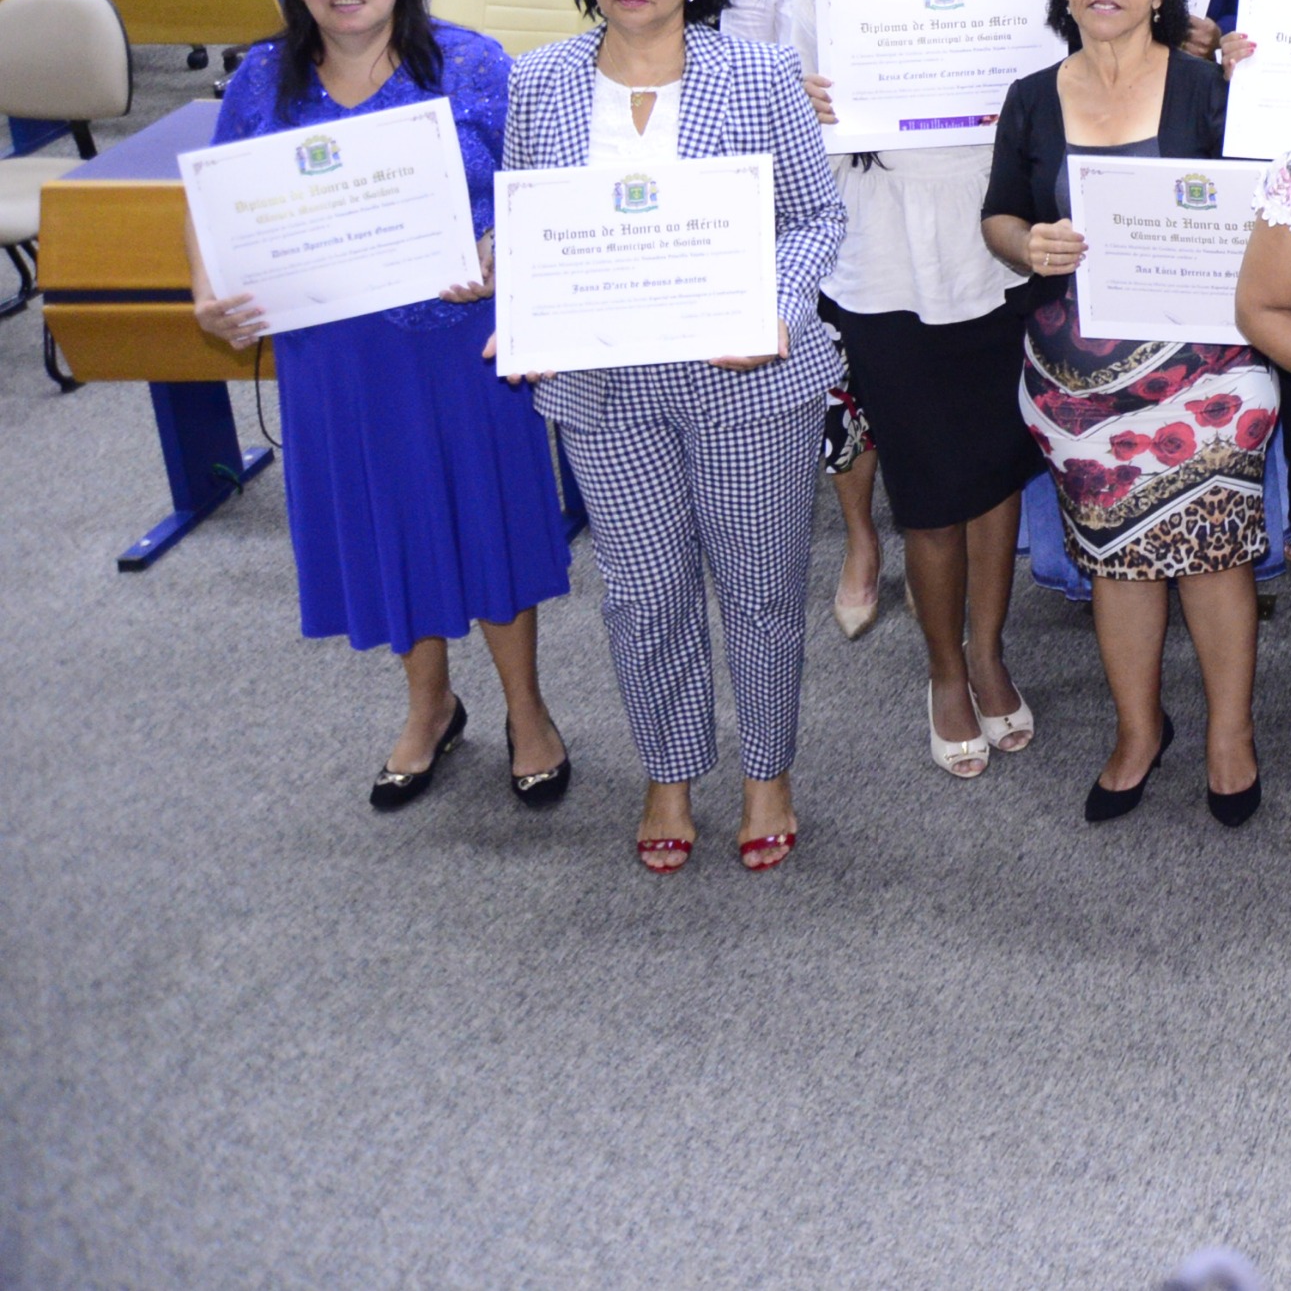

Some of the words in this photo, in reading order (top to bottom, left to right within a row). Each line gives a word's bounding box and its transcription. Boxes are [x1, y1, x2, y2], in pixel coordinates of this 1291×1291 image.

[860, 22, 907, 34] Diploma
[913, 21, 924, 31] de
[930, 19, 966, 30] Honra
[971, 19, 984, 27] ao
[989, 15, 1027, 27] Mérito
[878, 38, 913, 47] Câmara
[917, 35, 961, 45] Municipal
[965, 34, 974, 42] de
[977, 33, 1011, 41] Goiânia
[235, 195, 287, 213] Diploma
[291, 188, 304, 201] de
[310, 181, 349, 197] Honra
[353, 175, 367, 187] ao
[373, 166, 414, 183] Mérito
[543, 228, 596, 242] Diploma
[602, 225, 615, 237] de
[620, 222, 661, 235] Honra
[666, 223, 680, 233] ao
[686, 218, 729, 230] Mérito
[1113, 214, 1160, 228] Diploma
[1166, 217, 1177, 228] de
[1182, 218, 1219, 230] Honra
[562, 245, 602, 255] Câmara
[606, 241, 655, 252] Municipal
[660, 240, 669, 248] de
[673, 237, 711, 247] Goiânia
[1130, 232, 1167, 242] Câmara
[1170, 234, 1215, 245] Municipal
[1219, 237, 1228, 245] de
[1135, 265, 1151, 273] Ana
